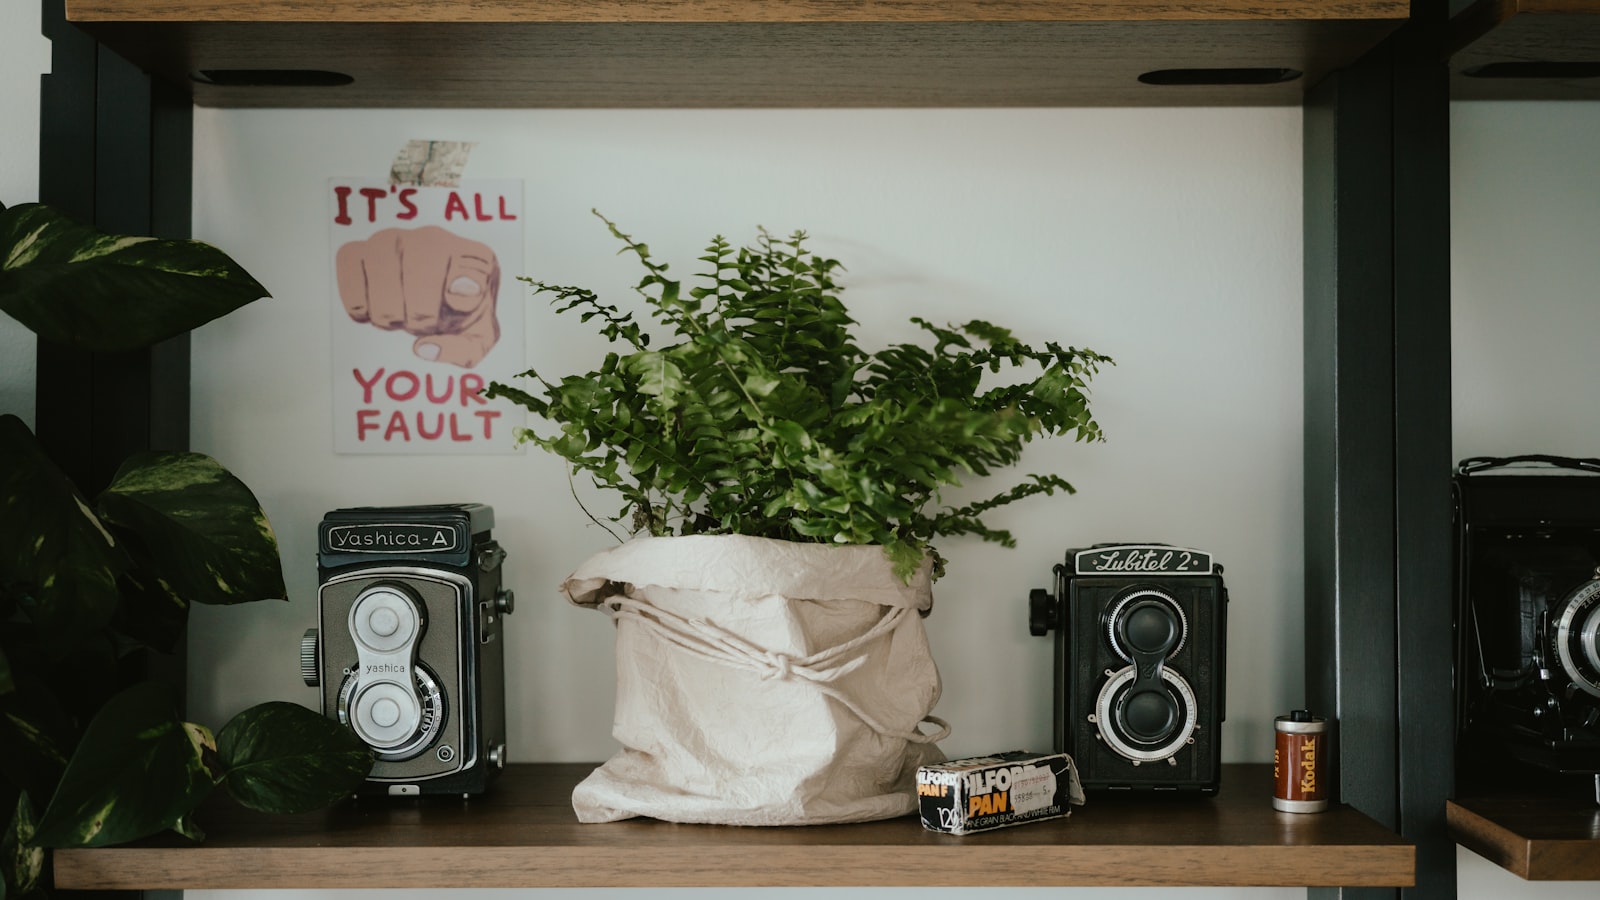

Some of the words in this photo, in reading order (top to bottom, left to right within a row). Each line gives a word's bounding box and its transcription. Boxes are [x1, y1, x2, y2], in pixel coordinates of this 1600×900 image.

[334, 185, 418, 225] IT'S
[444, 191, 517, 222] ALL
[352, 367, 487, 406] YOUR
[356, 409, 501, 442] FAULT
[335, 530, 448, 546] Yashica-A
[1096, 550, 1173, 571] Lubitel
[1176, 551, 1191, 571] 2
[1582, 591, 1600, 609] ZEIS
[366, 664, 405, 674] yashica
[1301, 738, 1315, 792] Kodak
[918, 784, 941, 798] PAN
[941, 785, 948, 798] F
[968, 765, 1037, 796] ILFO
[968, 791, 1007, 818] PAN
[937, 807, 959, 829] 120
